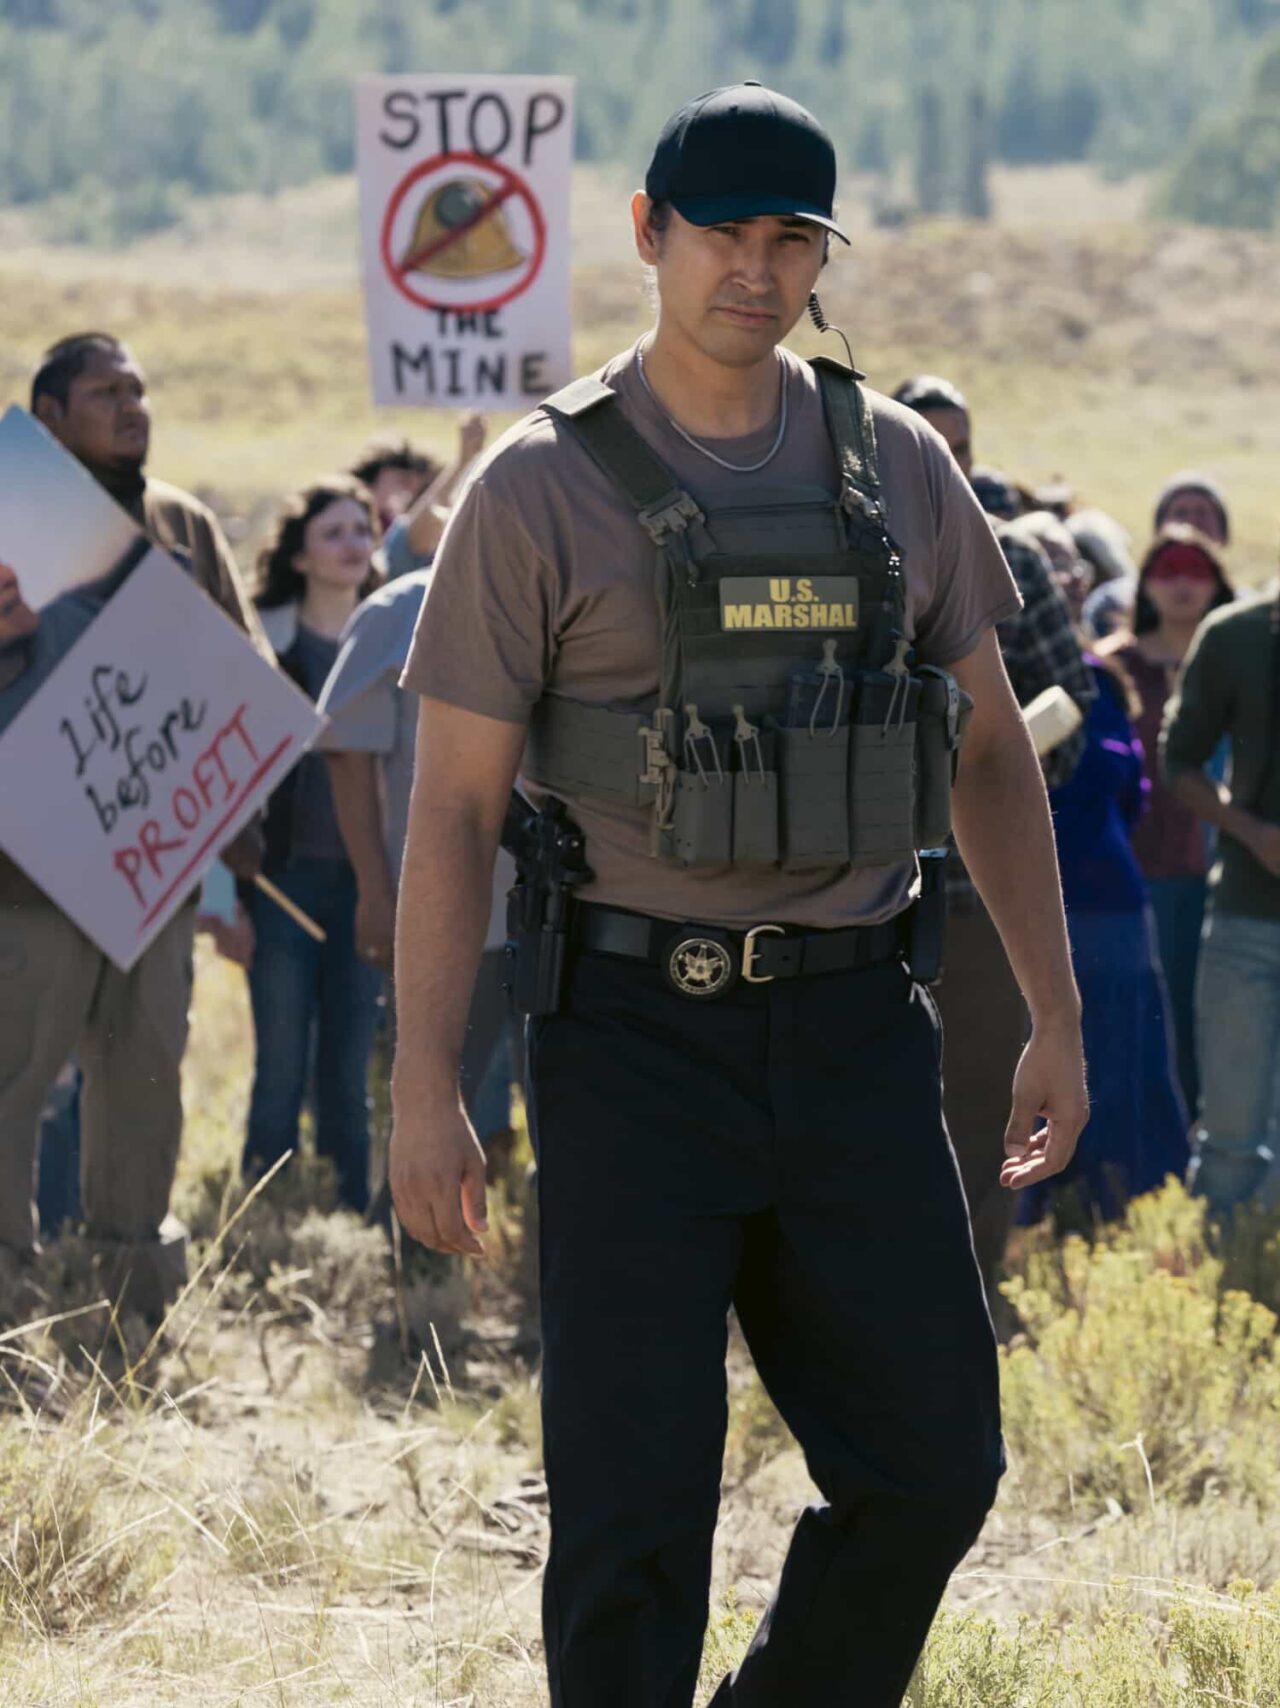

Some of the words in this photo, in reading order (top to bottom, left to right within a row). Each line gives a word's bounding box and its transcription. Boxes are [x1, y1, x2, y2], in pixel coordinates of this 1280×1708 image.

[379, 89, 564, 165] STOP
[429, 304, 503, 339] THE
[390, 341, 556, 396] MINE
[724, 603, 857, 629] MARSHAL
[769, 578, 820, 603] U.S.
[60, 664, 148, 777] Life
[85, 699, 207, 834] before
[113, 702, 261, 910] PROFIT
